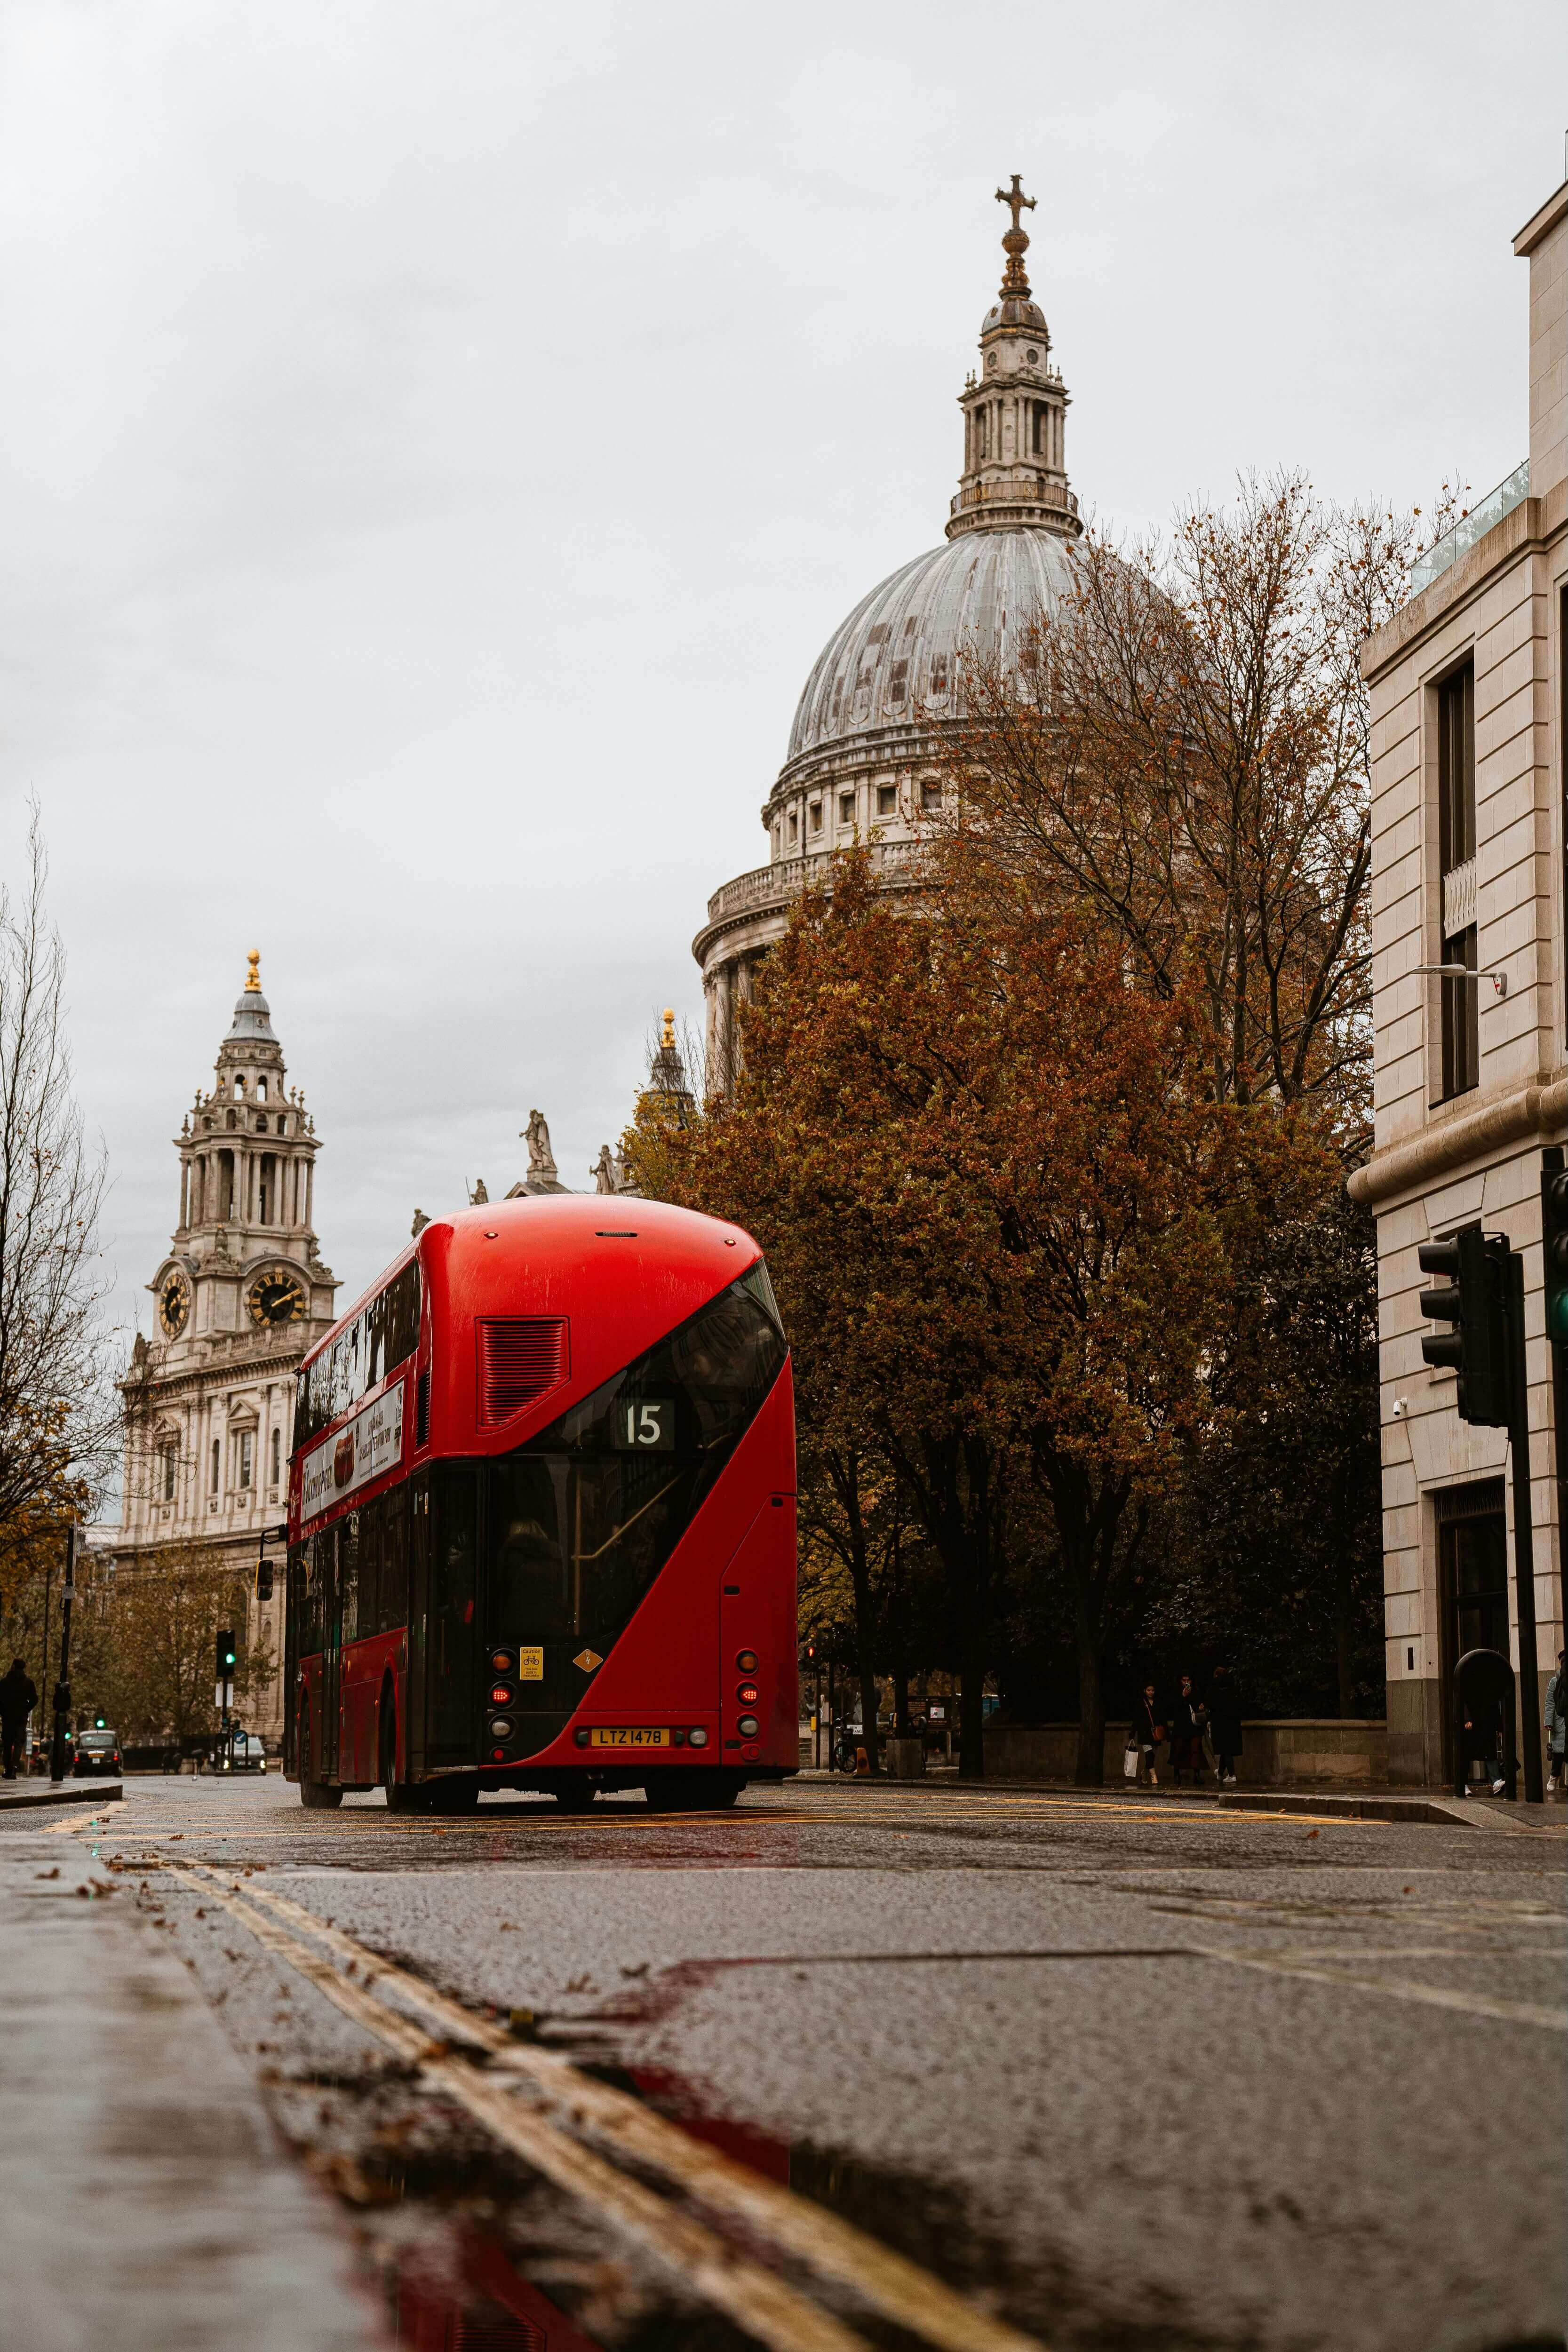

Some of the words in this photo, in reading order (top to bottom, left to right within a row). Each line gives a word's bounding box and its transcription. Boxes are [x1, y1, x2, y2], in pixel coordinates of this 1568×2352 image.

[628, 1405, 661, 1444] 15
[600, 1731, 627, 1744] LTZ
[630, 1731, 661, 1744] 1478
